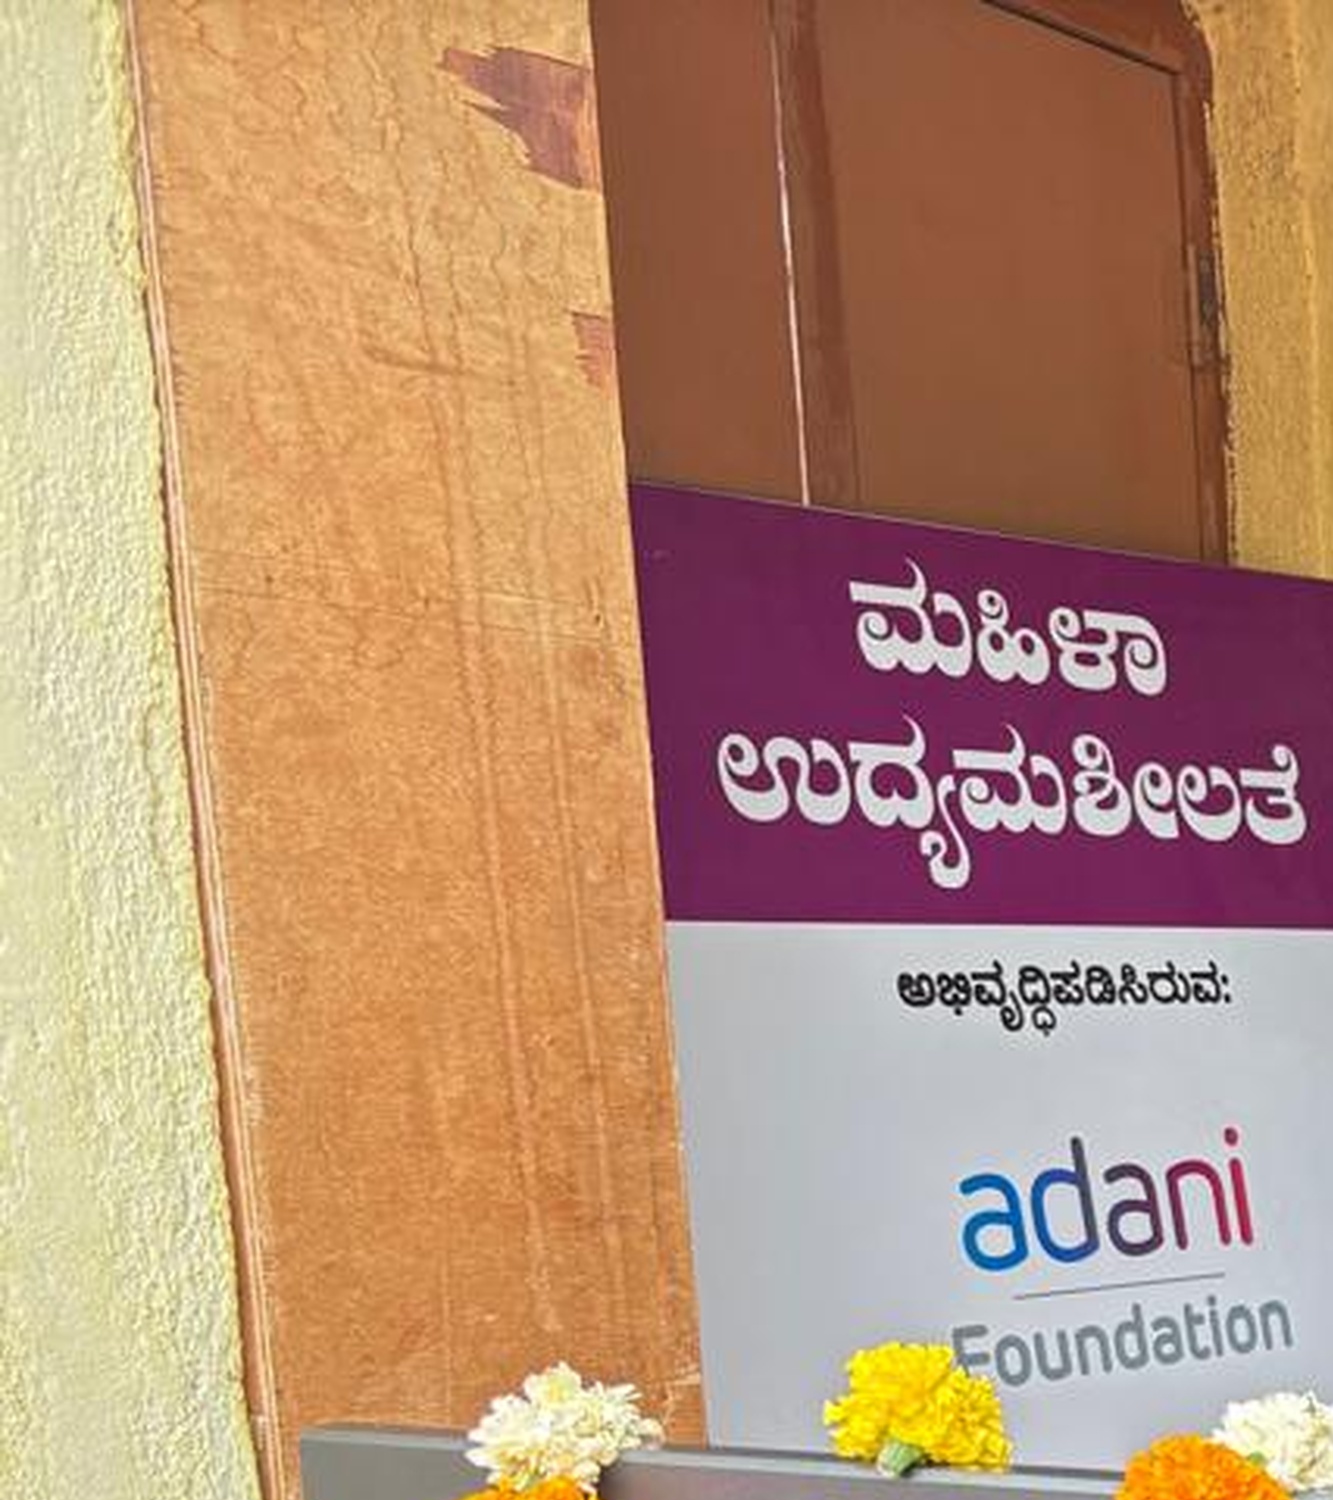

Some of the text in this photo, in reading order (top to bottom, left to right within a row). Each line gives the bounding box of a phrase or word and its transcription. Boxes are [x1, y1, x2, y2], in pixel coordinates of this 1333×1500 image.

[848, 557, 1168, 696] ಮಹಿಳಾ
[717, 716, 1308, 890] ಉದ್ಯಮಶೀಲತೆ
[897, 959, 1231, 1036] ಅಭಿವೃದ್ಧಿಪಡಿಸಿರುವ:
[959, 1127, 1253, 1272] adani
[952, 1294, 1294, 1387] Foundation
